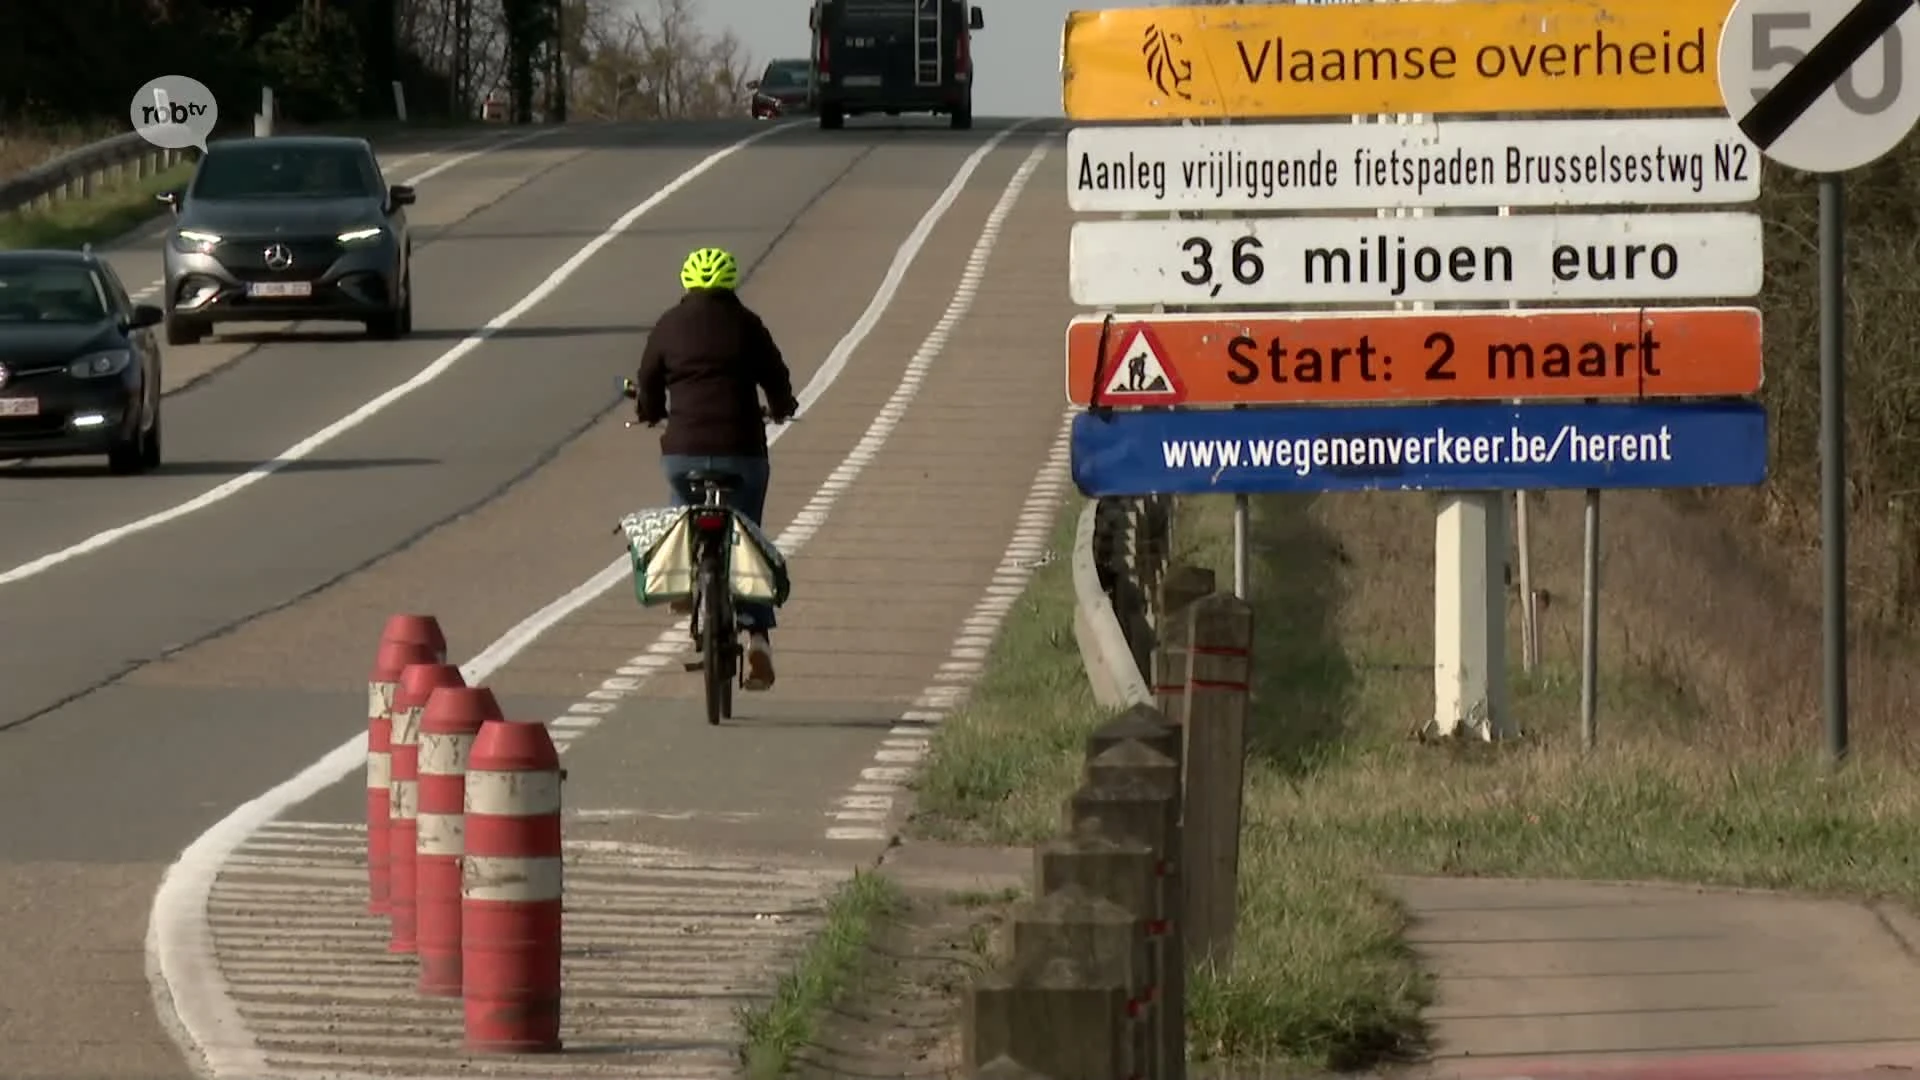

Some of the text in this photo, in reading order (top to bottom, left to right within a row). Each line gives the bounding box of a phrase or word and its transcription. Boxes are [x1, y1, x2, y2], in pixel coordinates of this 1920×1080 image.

[1237, 28, 1705, 84] Vlaamse overheid
[1751, 12, 1903, 116] 50
[1078, 143, 1749, 199] Aanleg vrijliggende fietspaden Brusselsestwg N2
[1180, 235, 1679, 297] 3,6 miljoen euro
[1226, 330, 1661, 386] Start: 2 maart
[1162, 424, 1672, 477] www.wegenenverkeer.be/herent
